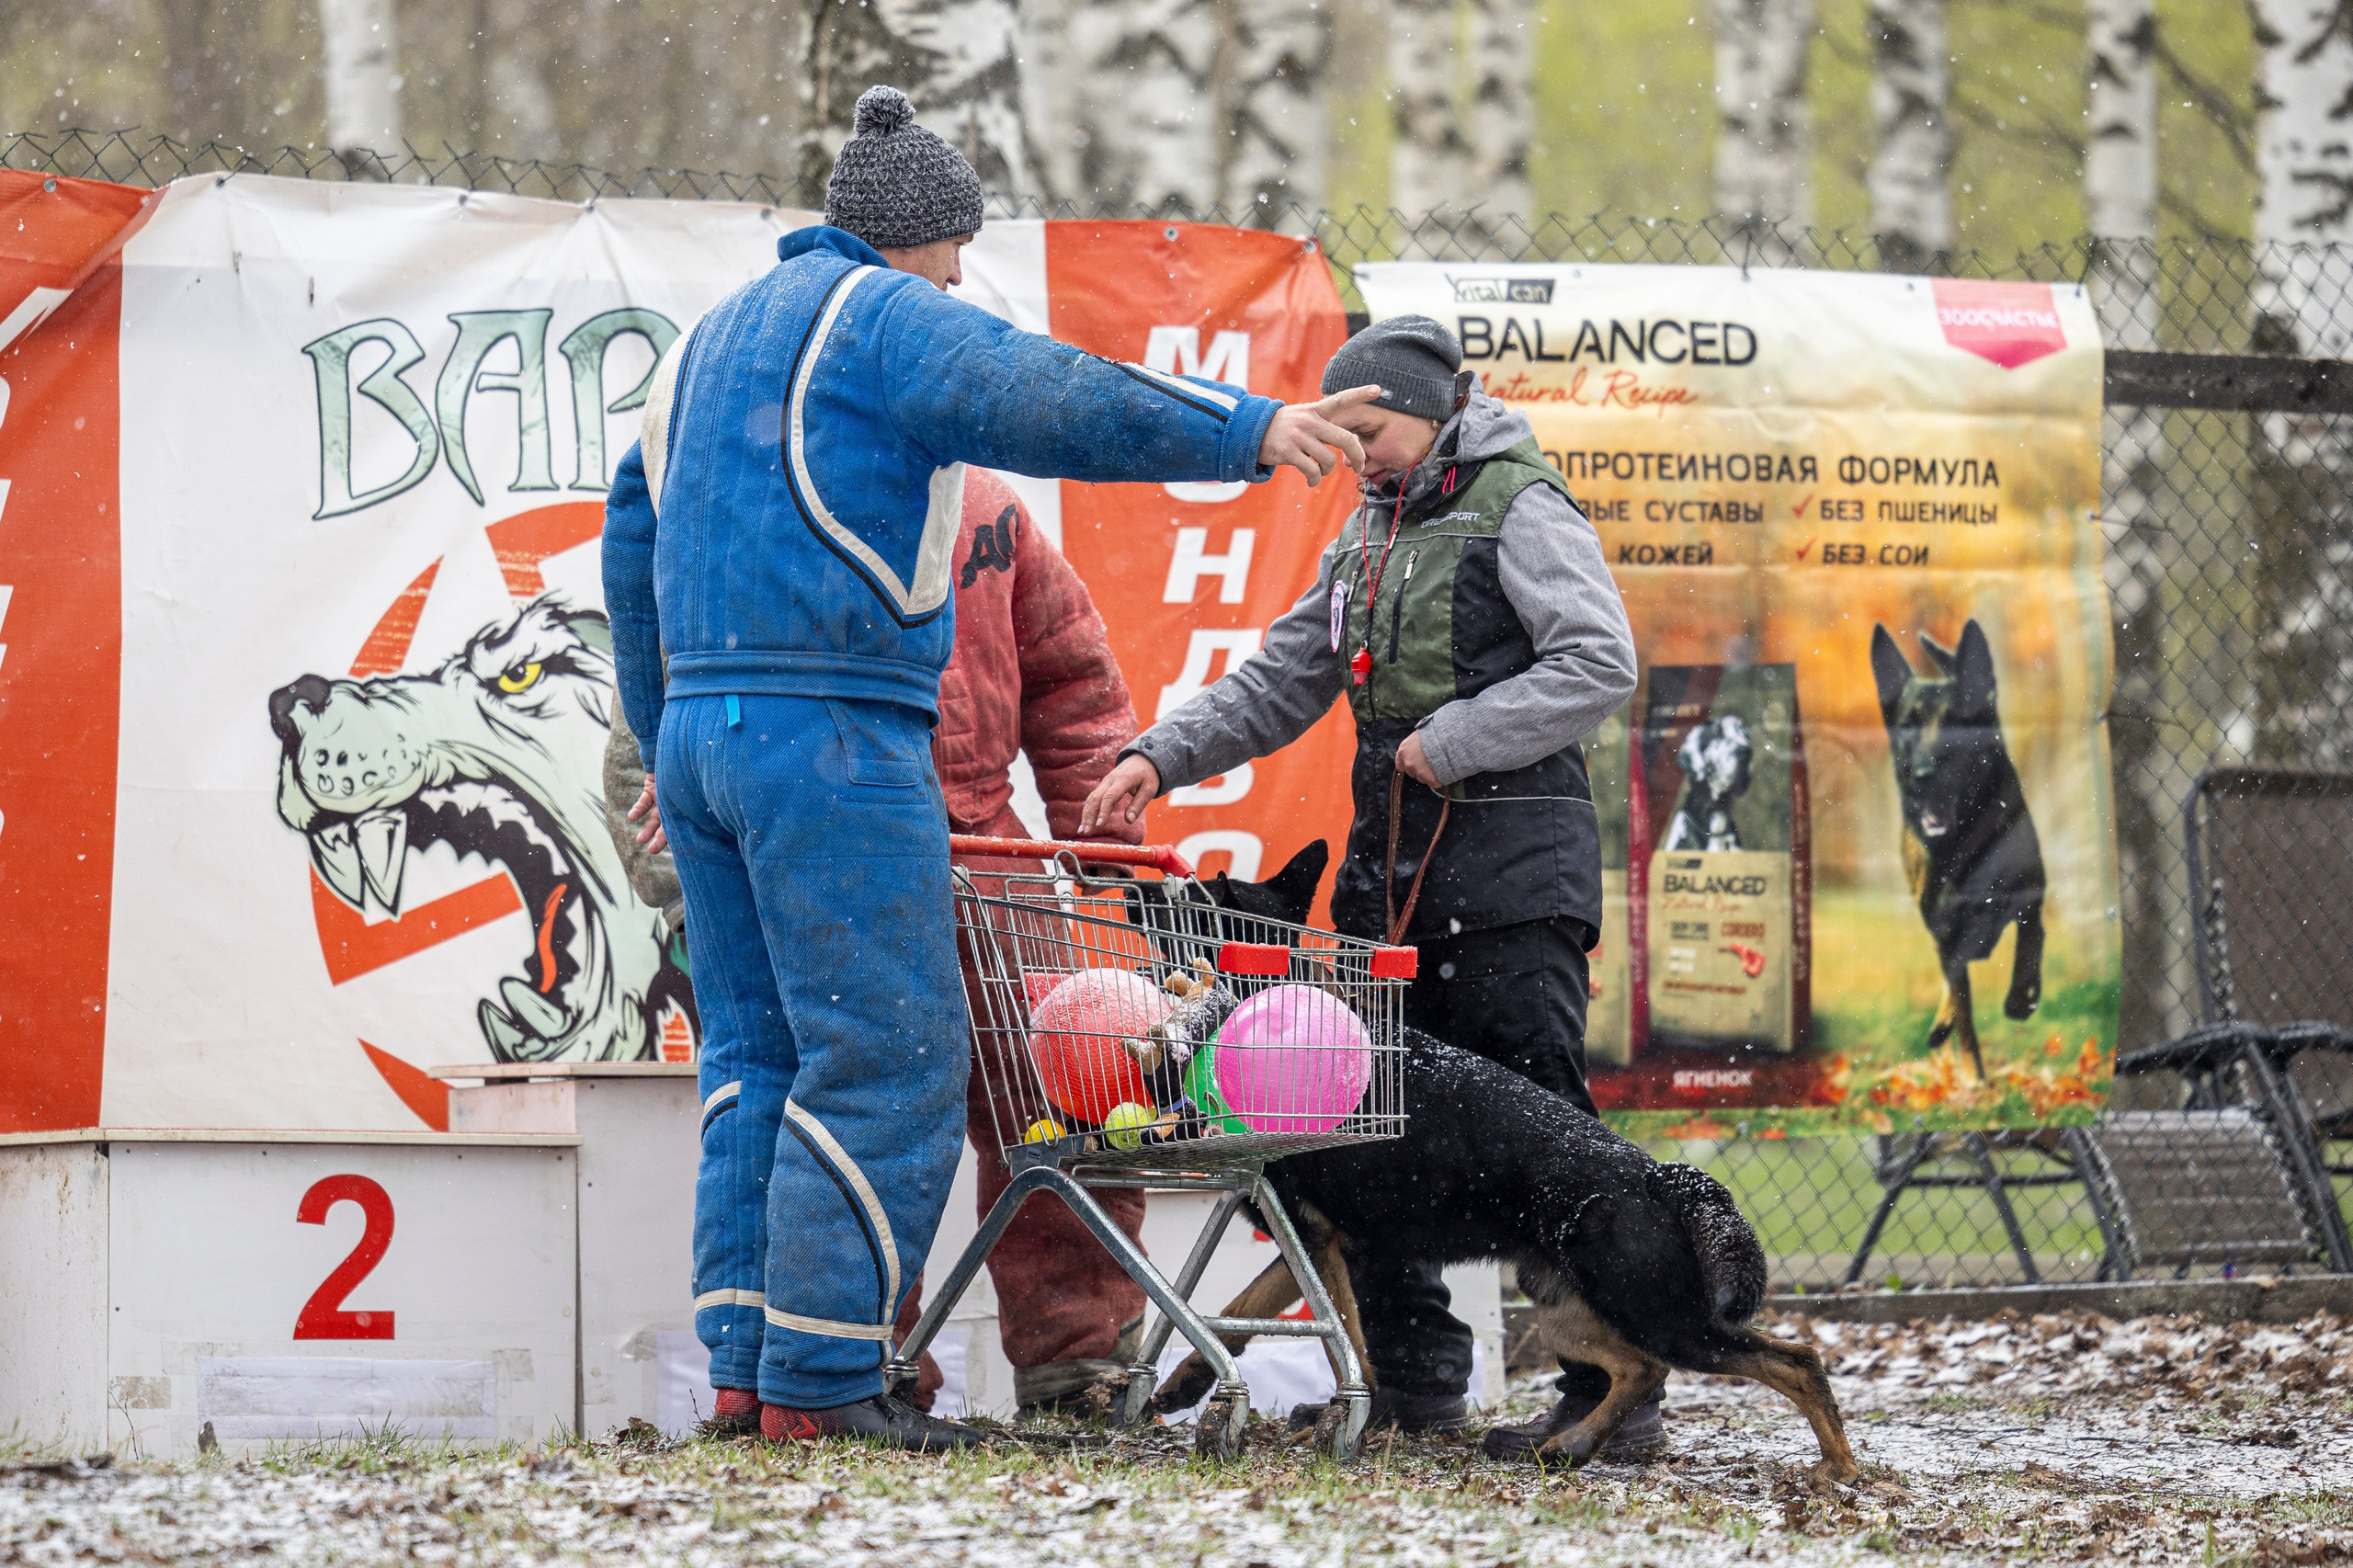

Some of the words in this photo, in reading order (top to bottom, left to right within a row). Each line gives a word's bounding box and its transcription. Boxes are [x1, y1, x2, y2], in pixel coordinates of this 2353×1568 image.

[1457, 315, 1757, 366] BALANCED
[1480, 367, 1591, 407] atural
[1599, 369, 1701, 418] Recipe
[1543, 450, 1819, 483] ОПРОТЕИНОВАЯ
[1837, 454, 2001, 487] ФОРМУЛА
[1577, 498, 1631, 522] ВЫЕ
[1643, 499, 1764, 524] СУСТАВЫ
[1820, 499, 1865, 522] БЕЗ
[1878, 500, 1998, 527] ПШЕНИЦЫ
[1618, 540, 1714, 566] КОЖЕЙ
[1822, 543, 1867, 566] БЕЗ
[1879, 544, 1929, 567] СОИ
[1663, 873, 1768, 897] BALANCED
[293, 1174, 395, 1340] 2
